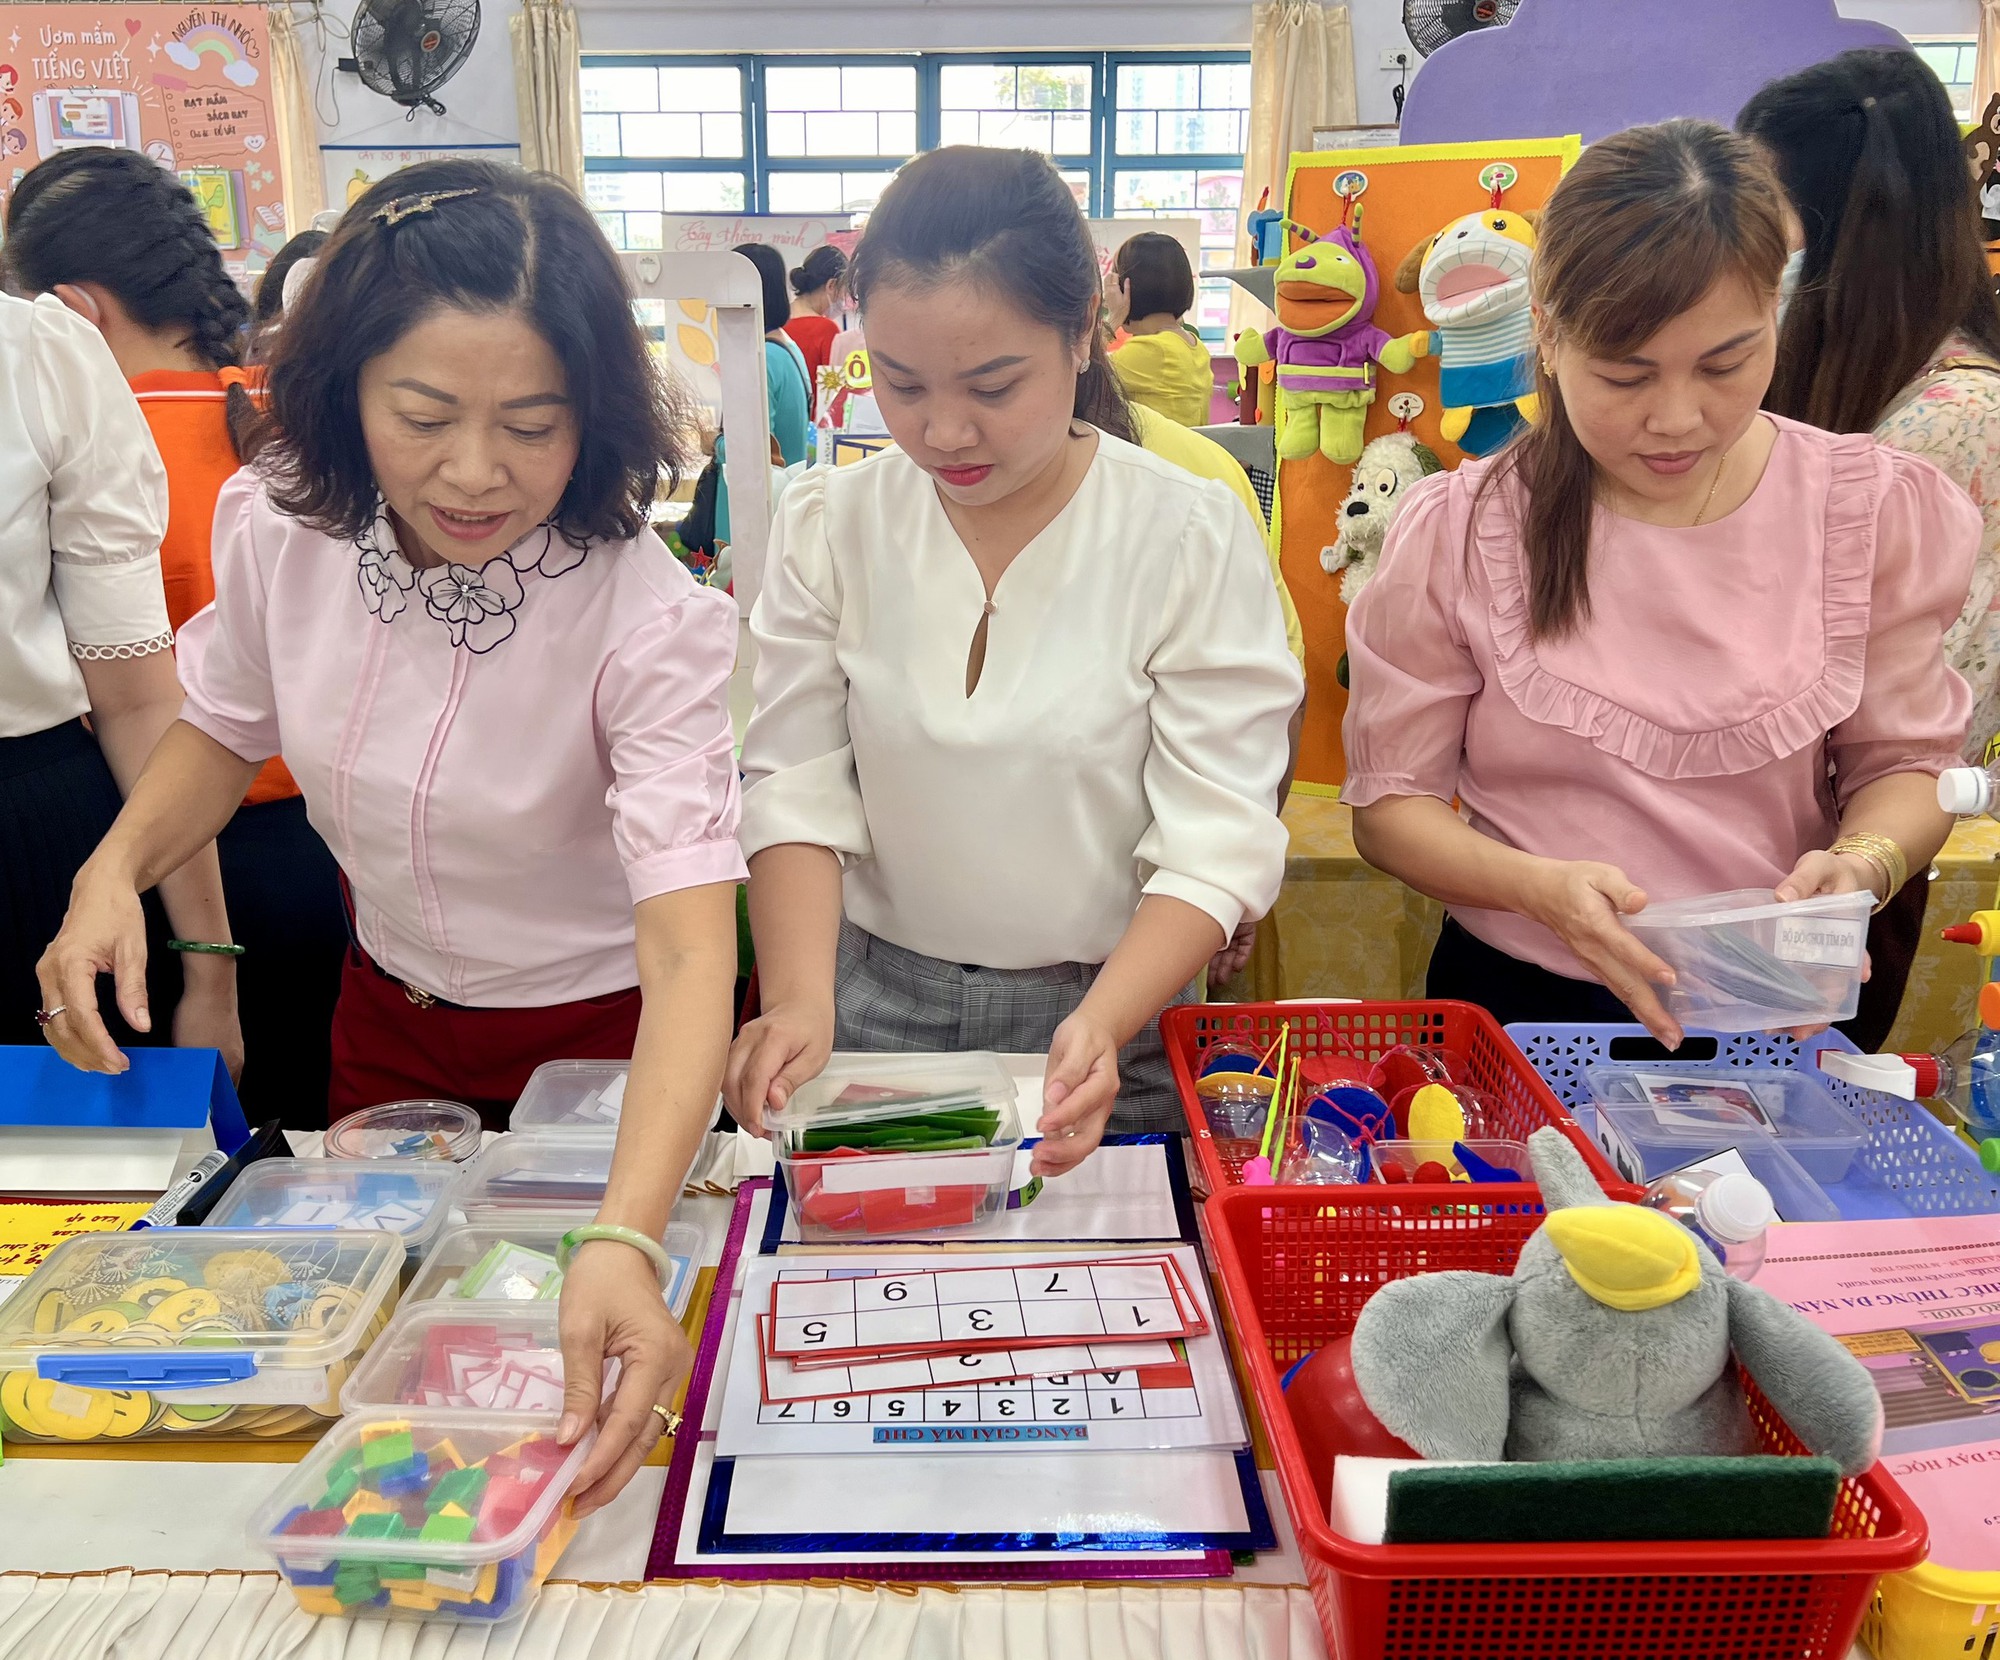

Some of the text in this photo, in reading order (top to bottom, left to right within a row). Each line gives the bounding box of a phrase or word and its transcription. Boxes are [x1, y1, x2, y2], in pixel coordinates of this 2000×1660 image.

[31, 47, 131, 85] TIẾNG VIỆT
[882, 1272, 1069, 1301] 7 9
[1840, 1295, 1875, 1309] ĐA
[1875, 1289, 1954, 1306] THÙNG
[802, 1305, 1151, 1345] 1 3 5
[777, 1397, 1125, 1418] 1 2 3 4 5 6 7
[1026, 1427, 1089, 1441] BẢNG
[1945, 1453, 1988, 1468] DẠY
